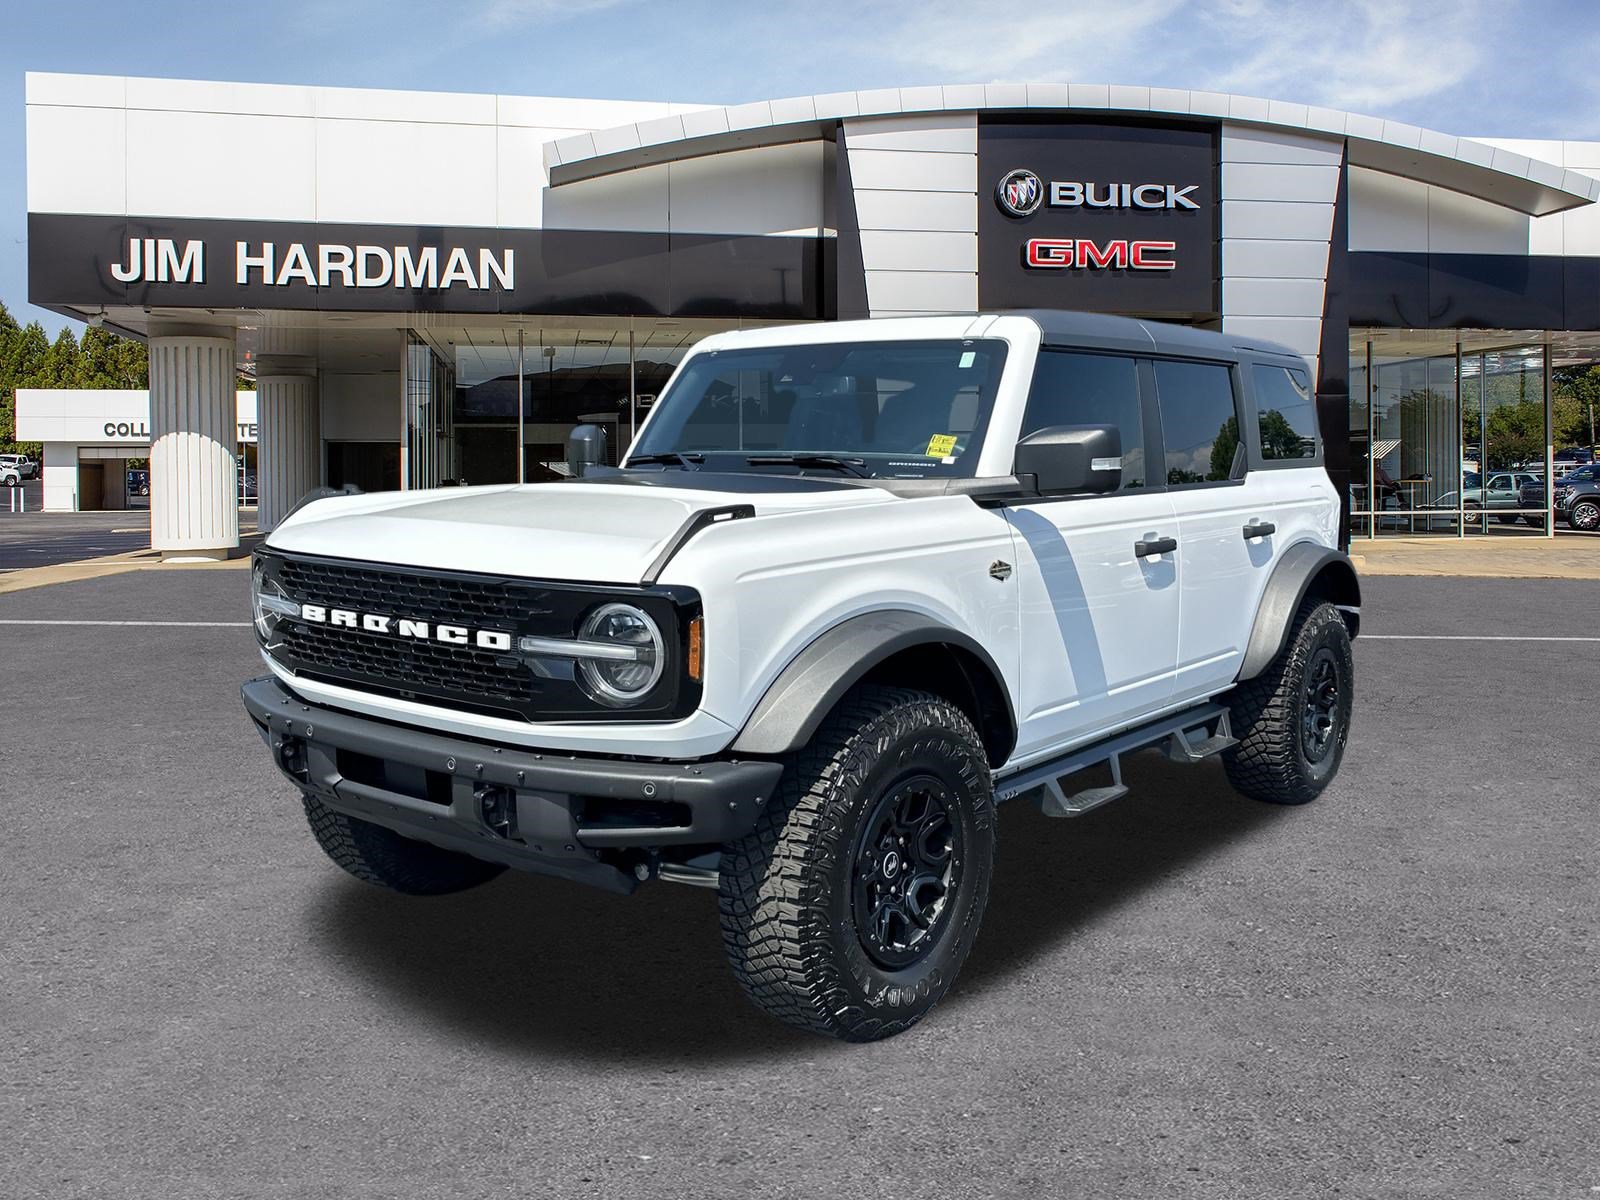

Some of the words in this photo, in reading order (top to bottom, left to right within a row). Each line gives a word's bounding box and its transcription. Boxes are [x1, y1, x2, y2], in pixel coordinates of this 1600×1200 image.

[1050, 181, 1201, 209] BUICK
[110, 238, 204, 284] JIM
[236, 240, 515, 291] HARDMAN
[1026, 238, 1177, 270] GMC
[302, 604, 511, 651] BRONCO
